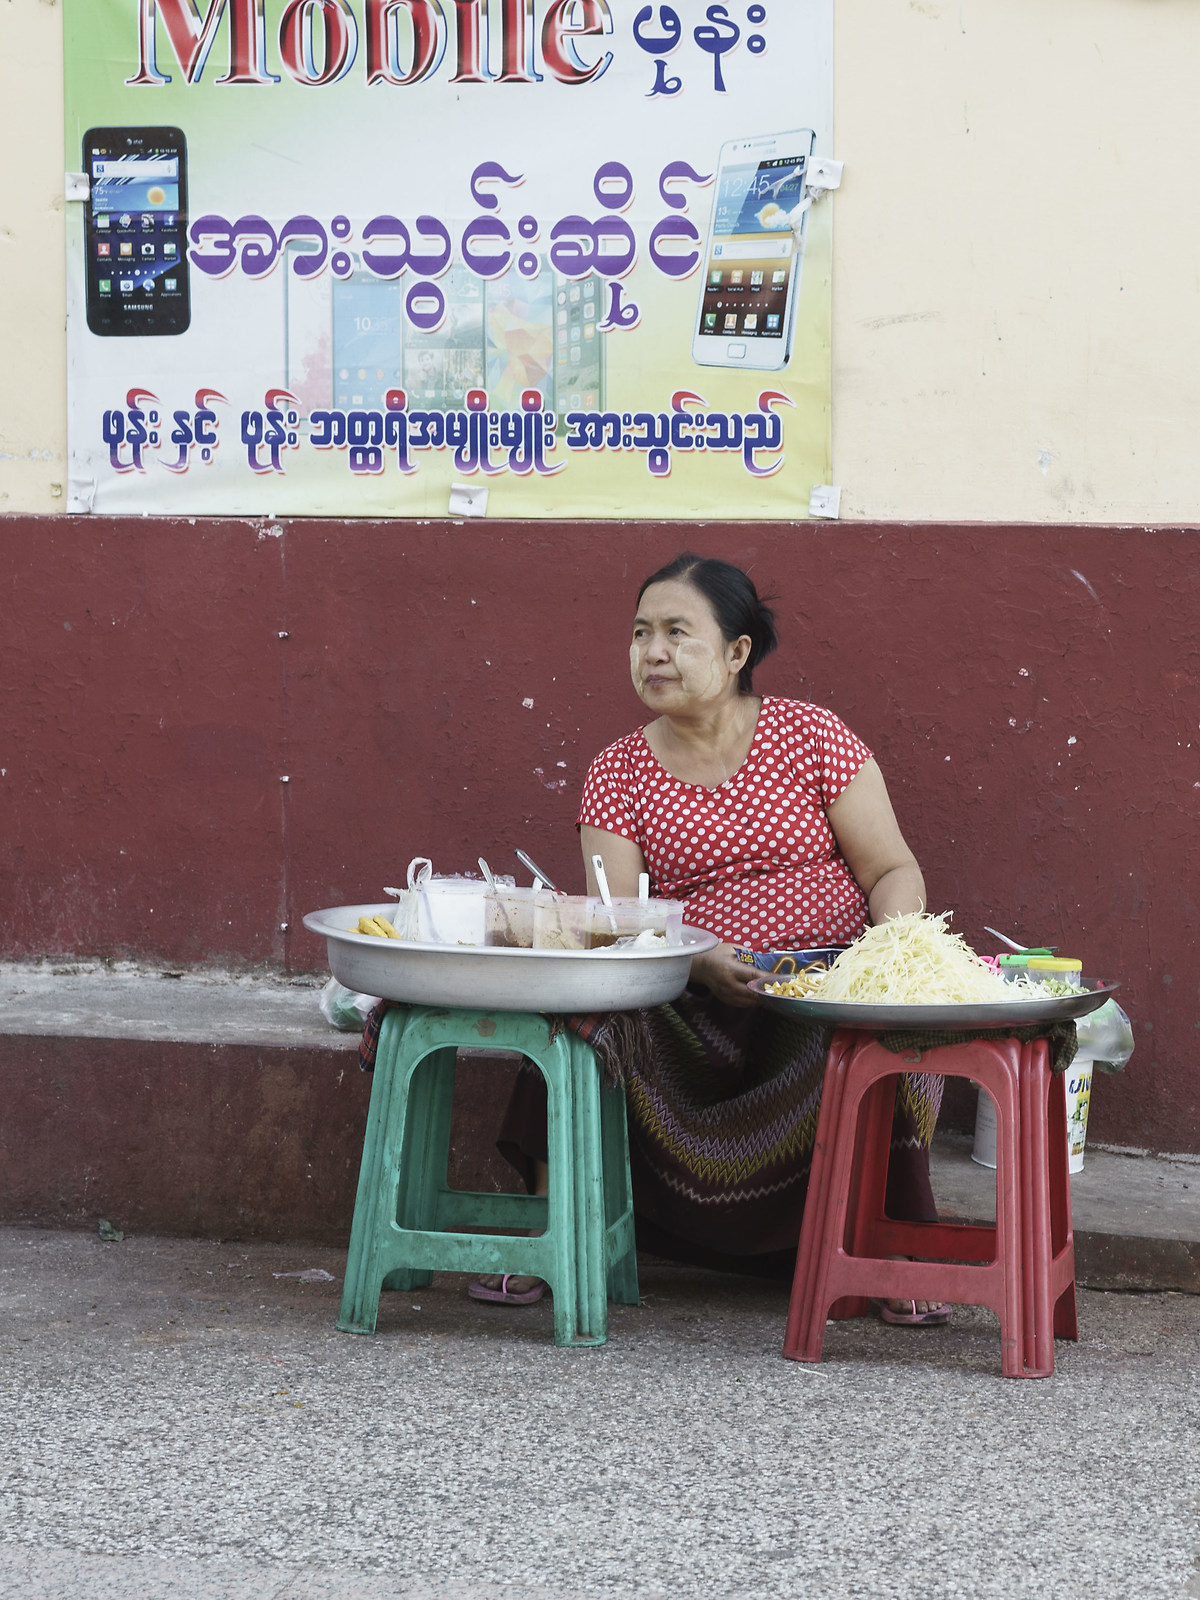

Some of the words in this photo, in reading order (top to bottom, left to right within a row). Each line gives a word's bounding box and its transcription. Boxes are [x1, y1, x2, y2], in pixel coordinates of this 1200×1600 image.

[124, 0, 614, 86] Mobile
[632, 0, 767, 98] ဖုနး
[187, 160, 715, 330] အားသွင်းဆိုင်
[102, 388, 162, 473] ဖုန်း
[241, 388, 301, 474] ဖုန်း
[566, 390, 797, 476] အားသွင်းသည်
